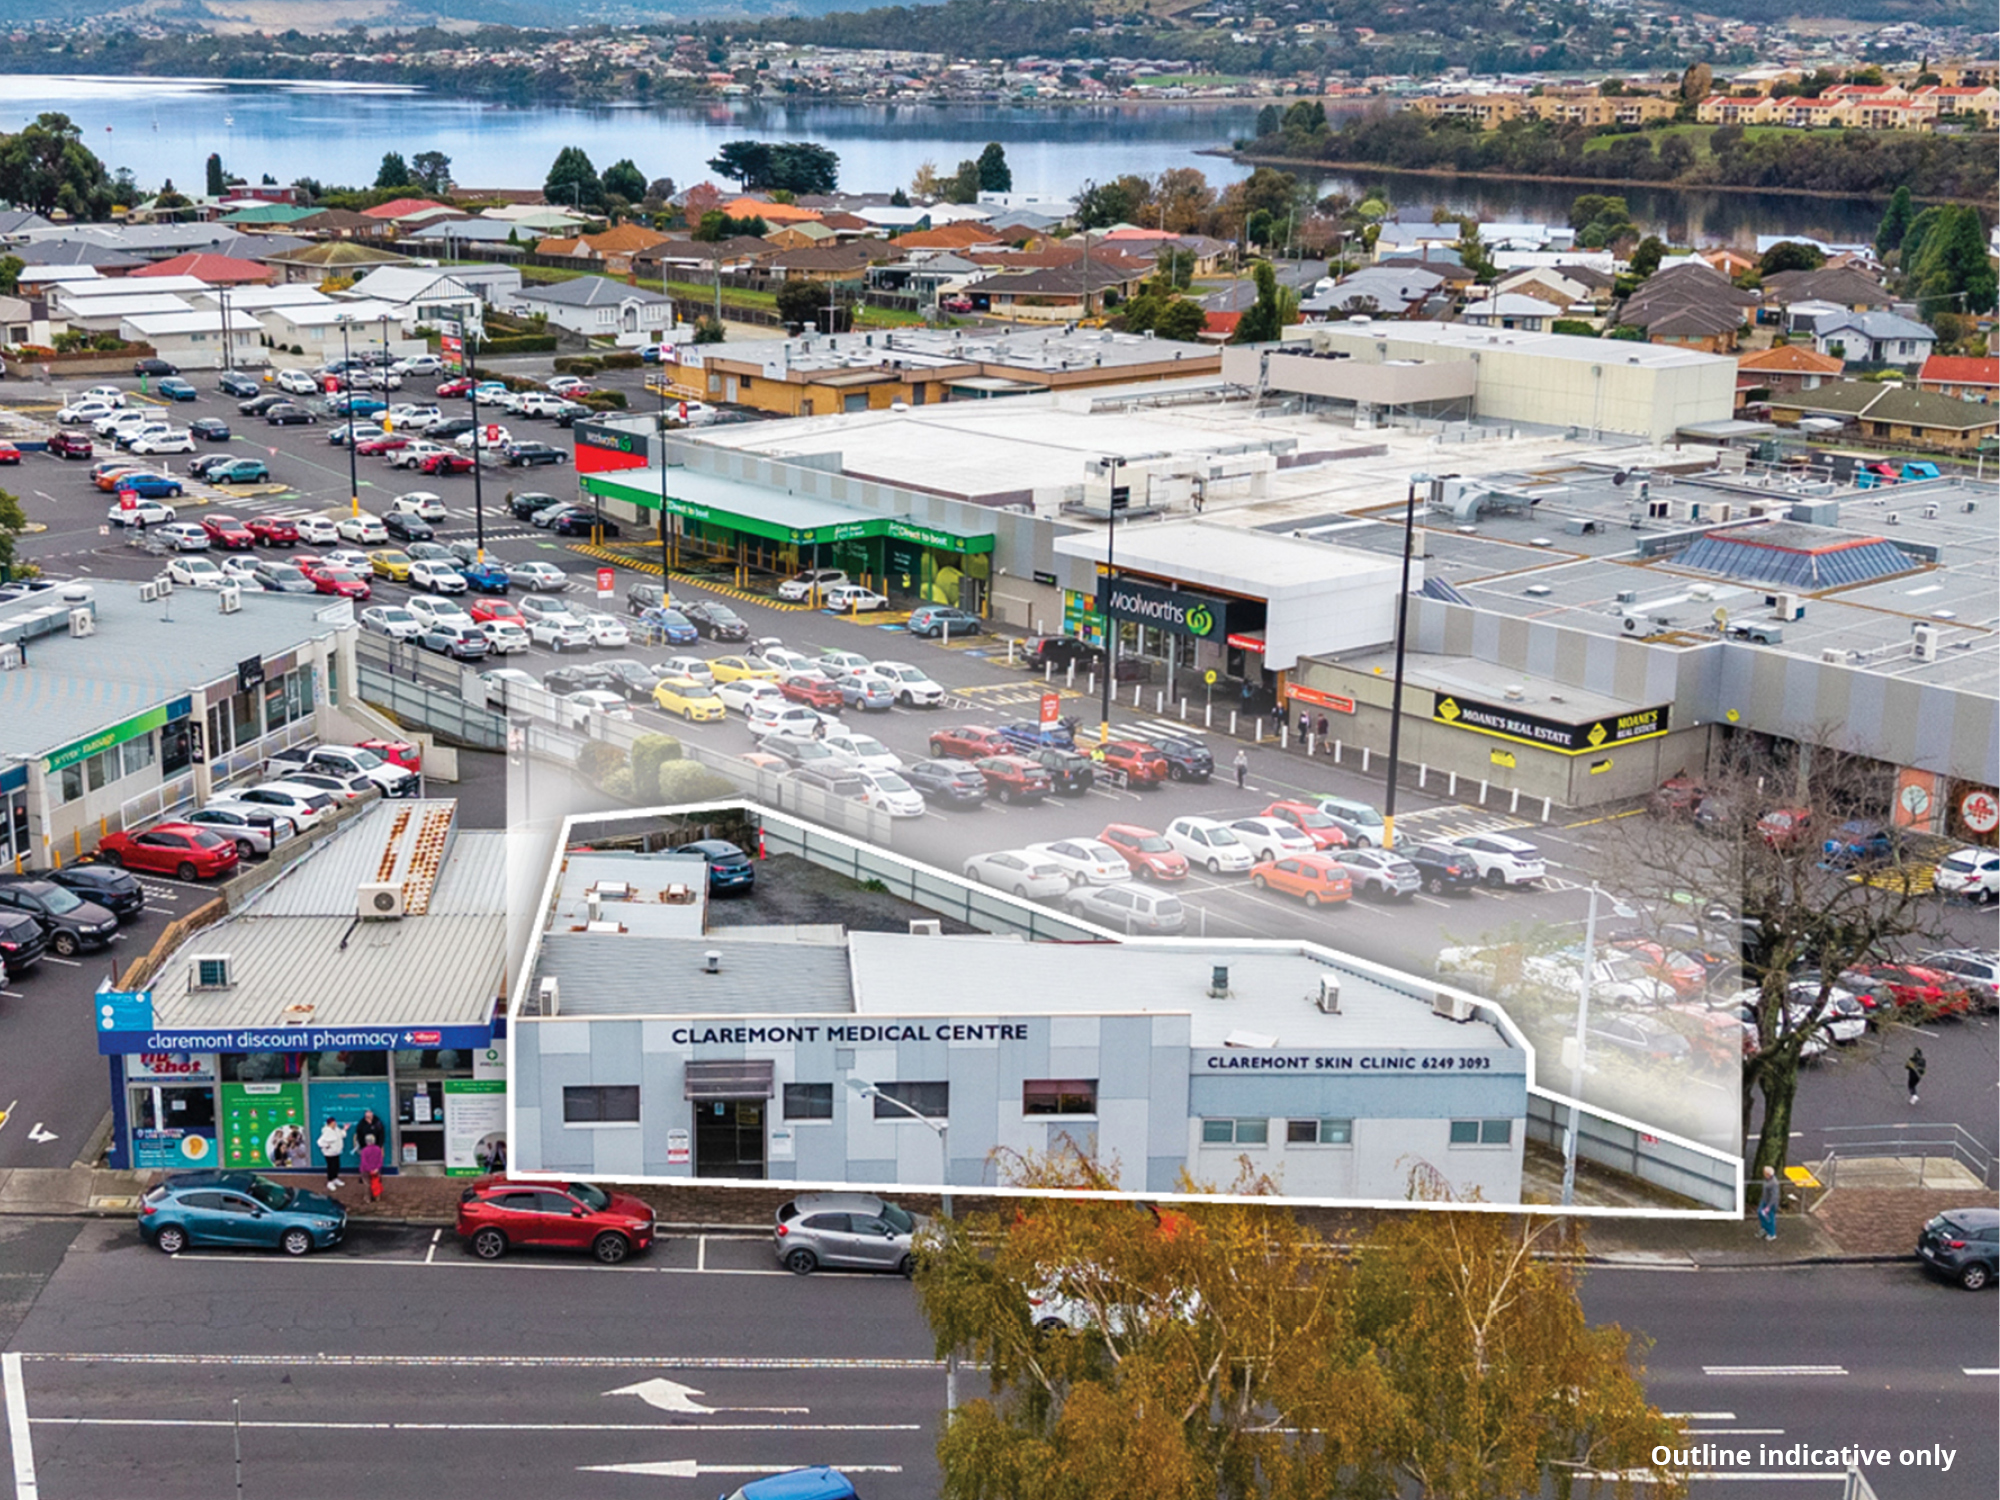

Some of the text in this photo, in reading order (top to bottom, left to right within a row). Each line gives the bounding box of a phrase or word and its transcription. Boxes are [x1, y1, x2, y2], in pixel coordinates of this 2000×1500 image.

[1462, 708, 1572, 745] MOANE'S REAL ESTATE
[1618, 710, 1658, 729] MOANE'S
[147, 1032, 233, 1049] claremont
[237, 1031, 308, 1047] discount
[313, 1030, 398, 1050] pharmacy
[672, 1024, 1028, 1044] CLAREMONT MEDICAL CENTRE
[153, 1060, 201, 1074] shot
[1207, 1057, 1490, 1069] CLAREMONT SKIN CLINIC 6249 3093
